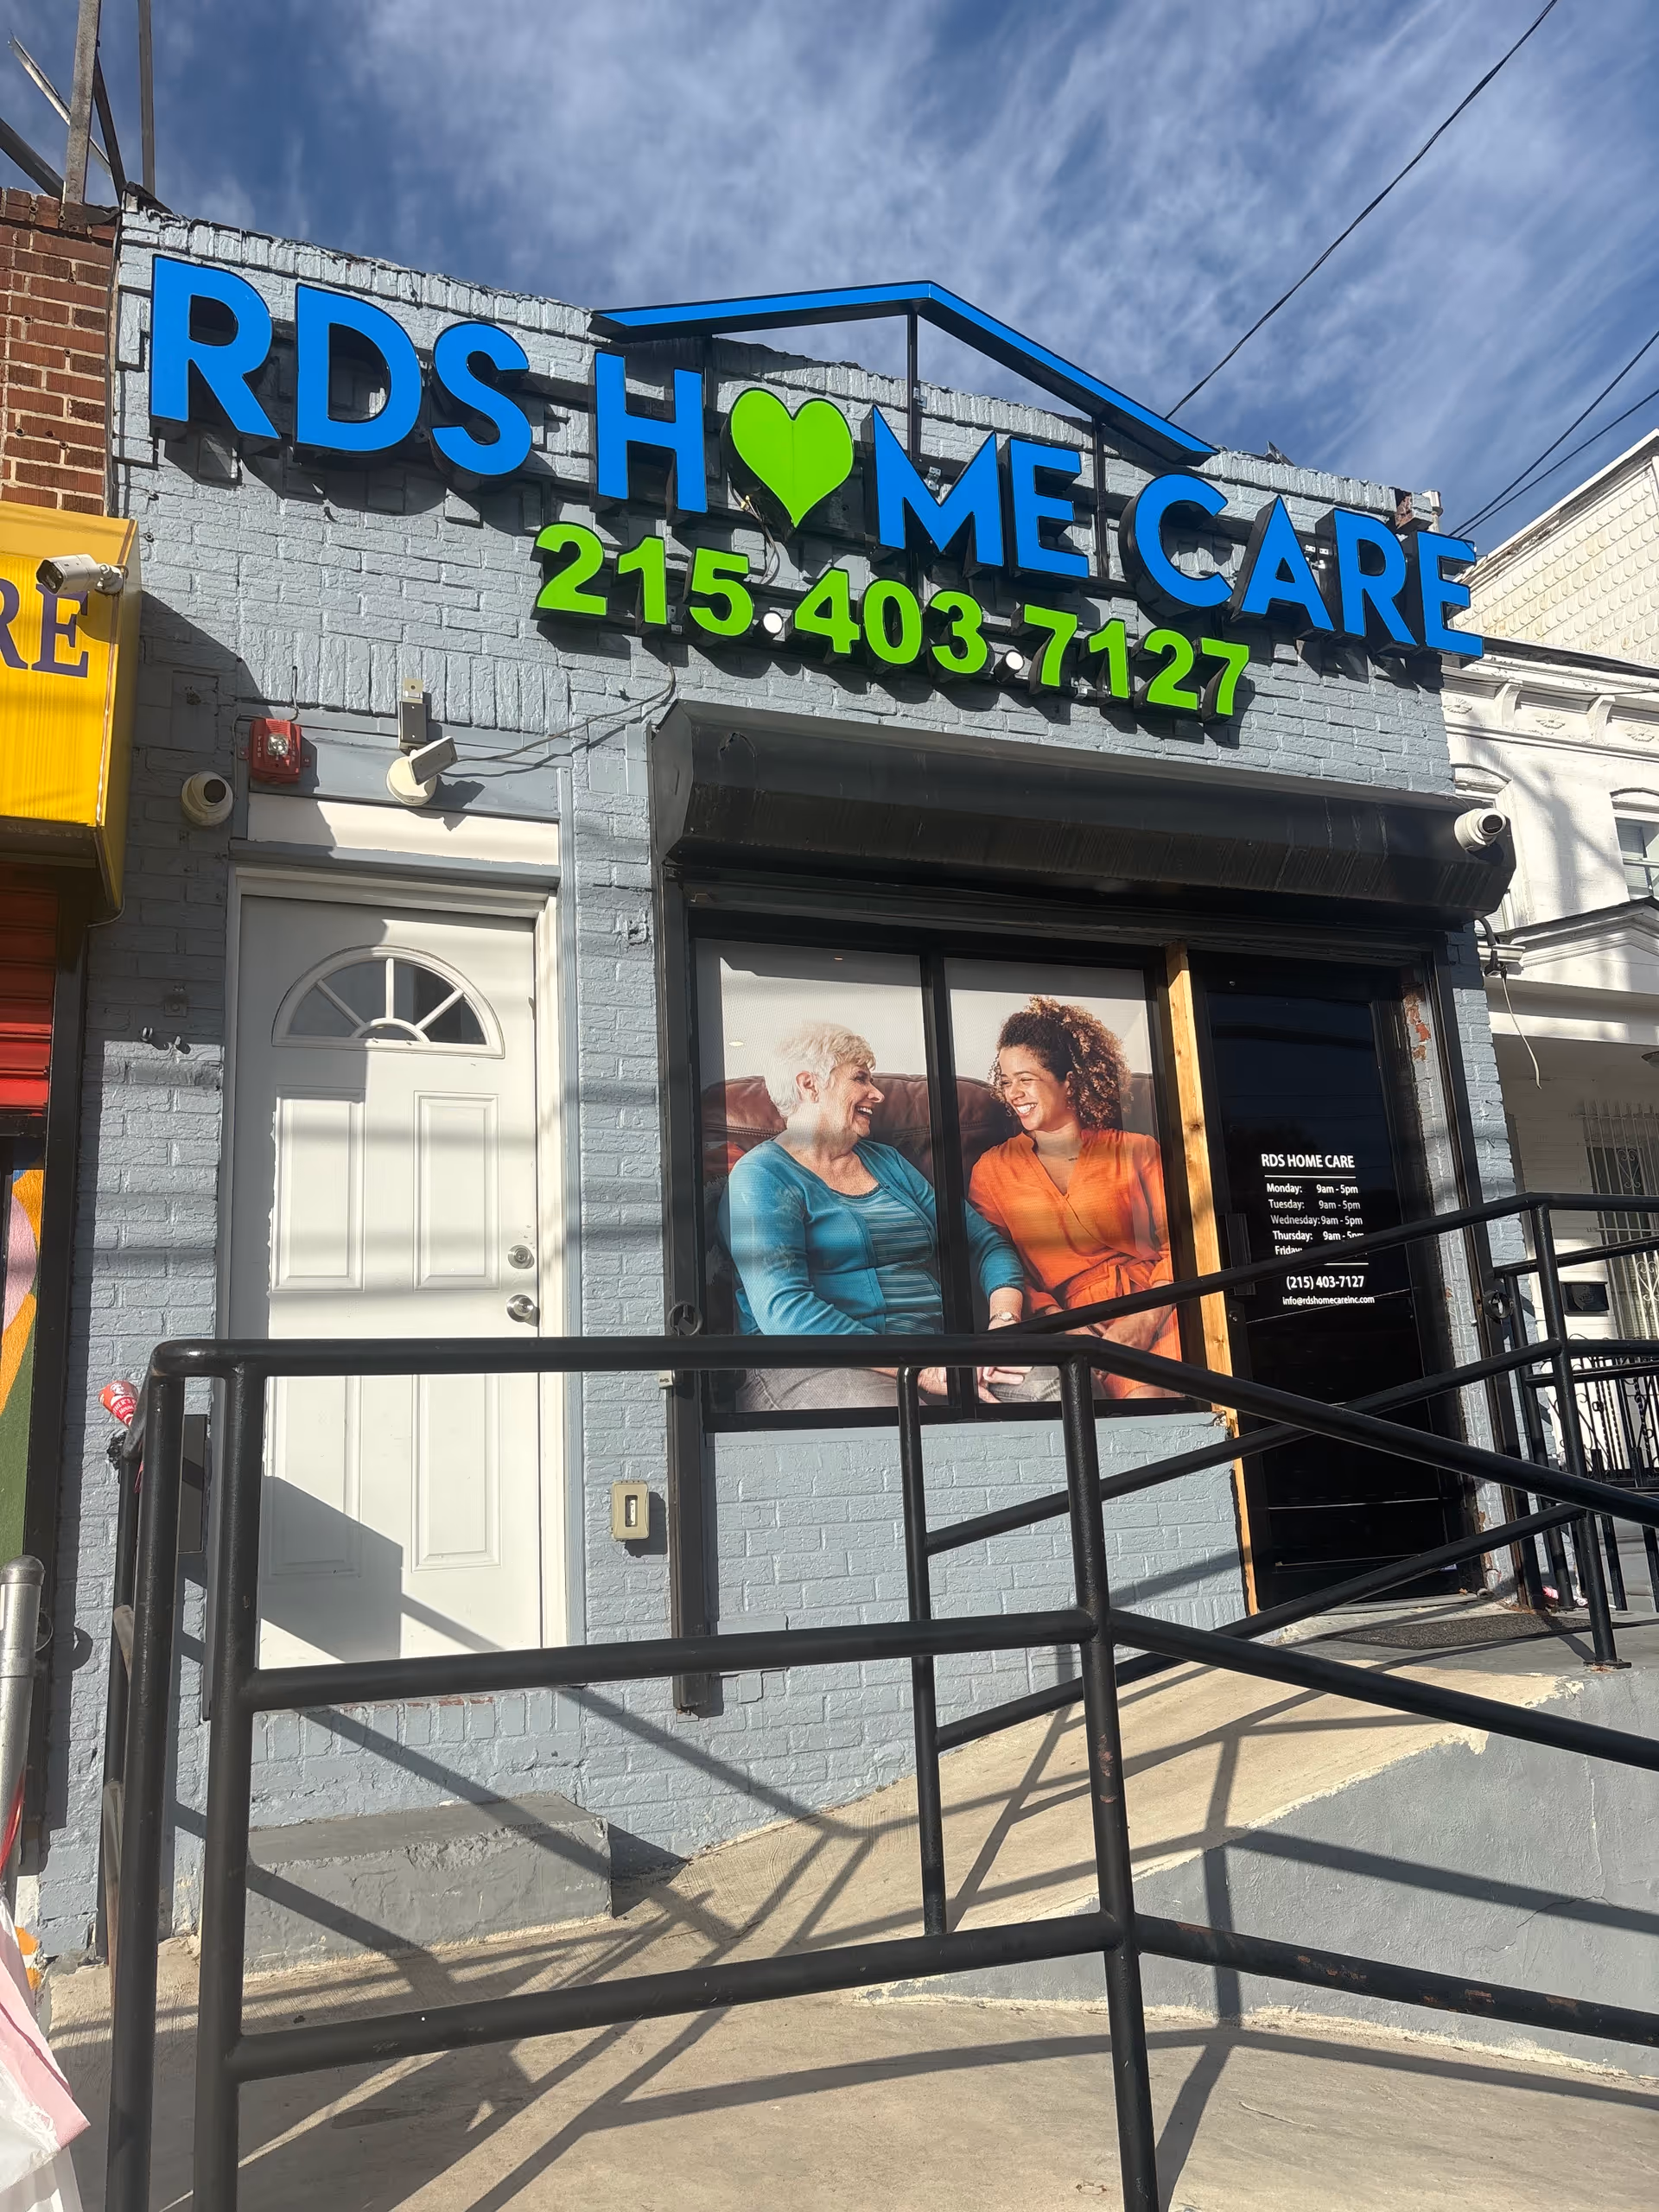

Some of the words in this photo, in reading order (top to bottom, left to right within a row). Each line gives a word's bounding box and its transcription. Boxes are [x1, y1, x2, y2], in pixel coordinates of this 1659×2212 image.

[150, 255, 533, 475] RDS
[1133, 472, 1484, 658] CARE
[1261, 1154, 1286, 1167] RDS
[1287, 1154, 1324, 1168] HOME
[1325, 1154, 1356, 1168] CARE
[1266, 1183, 1303, 1195] Monday:
[1316, 1184, 1335, 1194] 9am
[1340, 1184, 1359, 1196] 5pm
[1268, 1198, 1306, 1211] Tuesday:
[1318, 1199, 1337, 1210] 9am
[1342, 1200, 1361, 1212] 5pm
[1270, 1214, 1320, 1227] Wednesday:
[1320, 1215, 1339, 1225] 9am
[1344, 1215, 1363, 1227] 5pm
[1272, 1230, 1313, 1243] Thursday:
[1322, 1230, 1342, 1241] 9am
[1286, 1275, 1314, 1290] (215)
[1315, 1275, 1365, 1288] 403-7127
